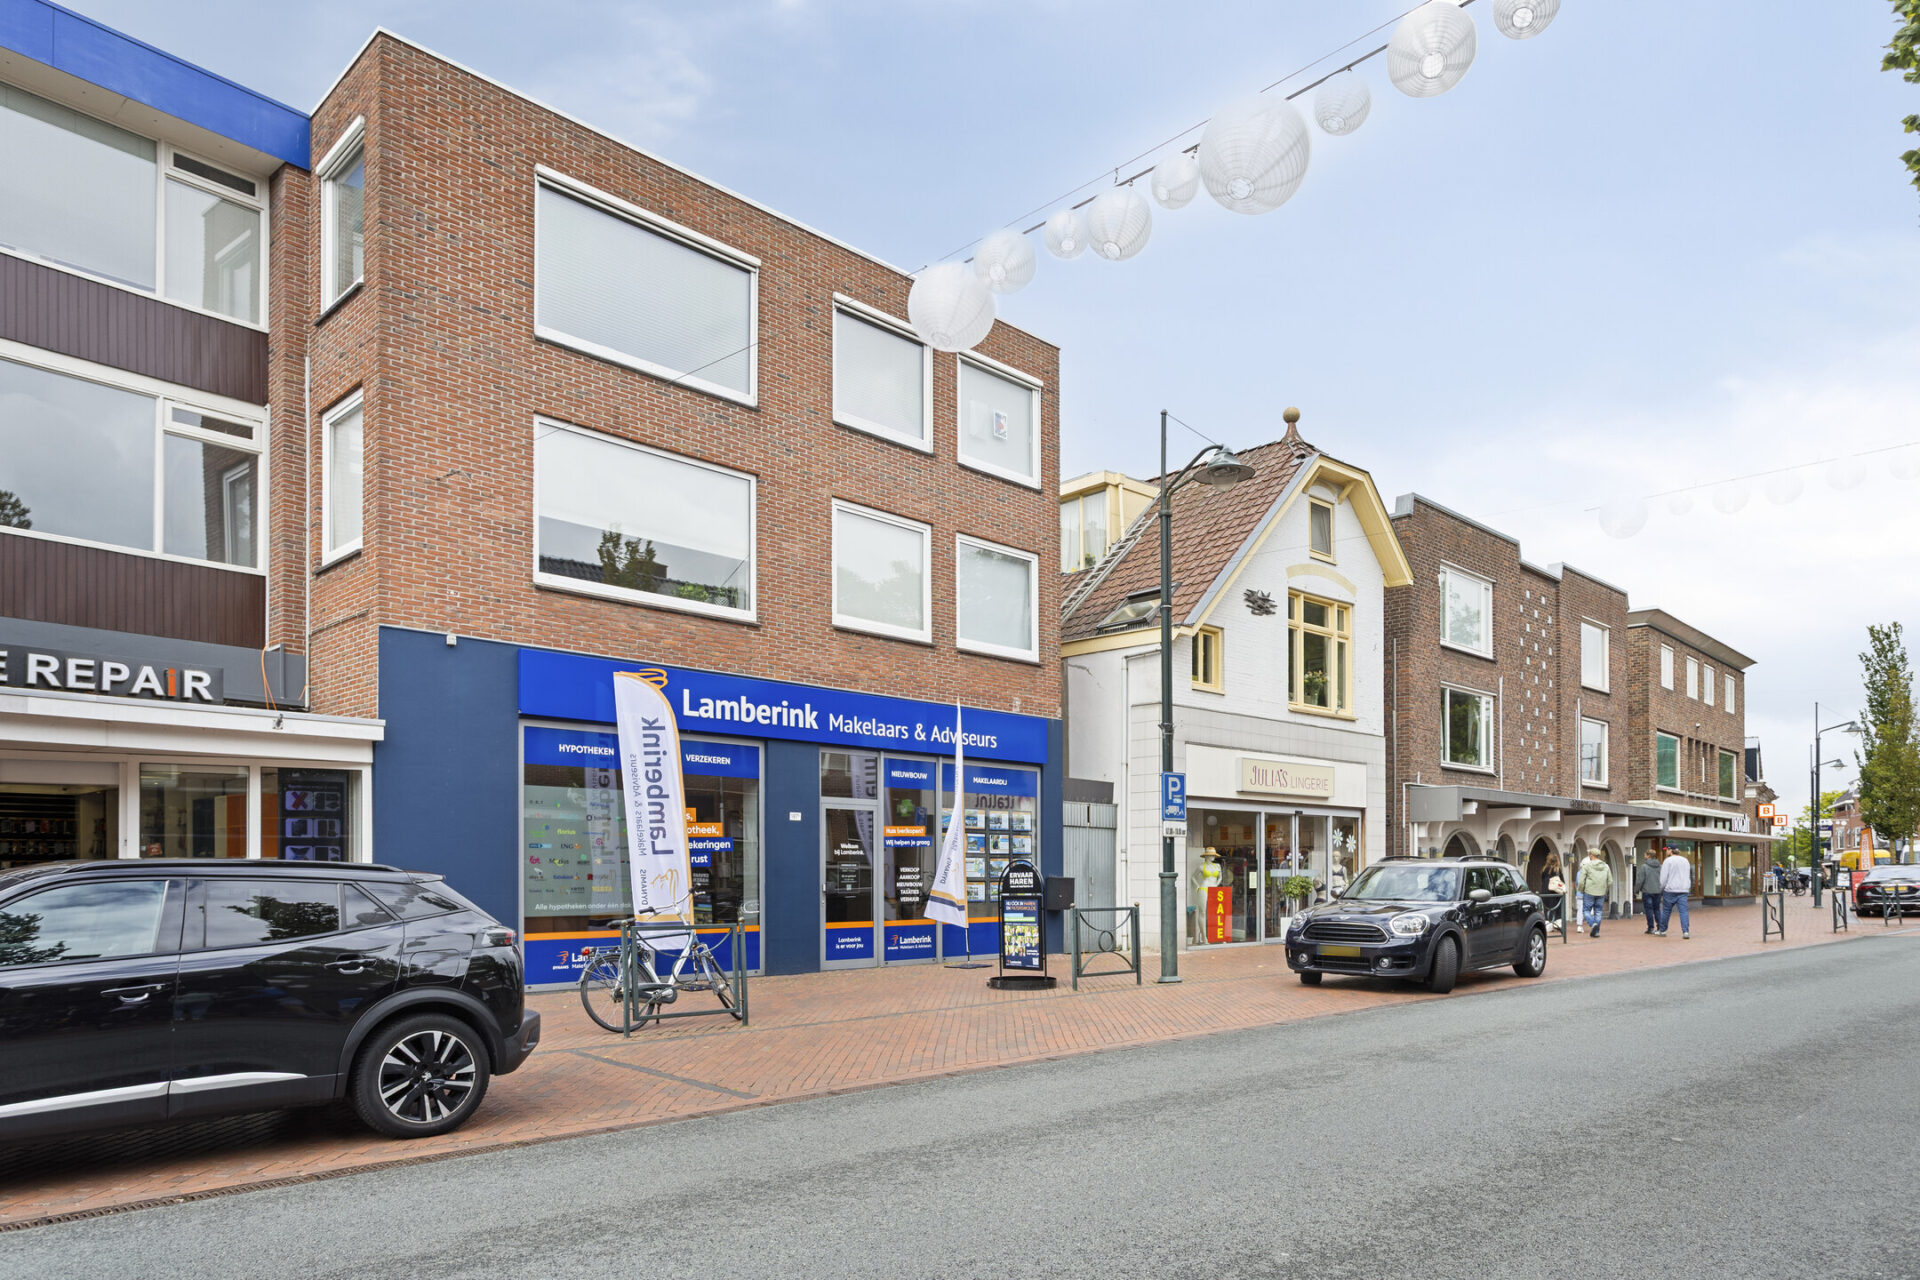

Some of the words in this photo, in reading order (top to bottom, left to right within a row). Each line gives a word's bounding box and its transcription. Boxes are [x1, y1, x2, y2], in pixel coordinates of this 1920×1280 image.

[682, 688, 819, 730] Lamberink
[828, 712, 909, 739] Makelaars
[914, 723, 927, 740] &
[930, 724, 998, 749] Advseurs
[558, 743, 615, 757] HYPOTHEKEN
[685, 753, 731, 766] VERZEKEREN
[891, 770, 928, 780] NIEUWBOUW
[1168, 776, 1181, 800] P
[1290, 775, 1329, 791] LINGERIE
[686, 825, 720, 836] otheek,
[688, 839, 731, 851] ekeringen
[691, 855, 708, 864] rust
[535, 903, 548, 911] Alle
[548, 902, 587, 912] hypotheken
[587, 902, 606, 910] onder
[1216, 890, 1225, 939] SALE
[899, 935, 932, 945] Lamberink
